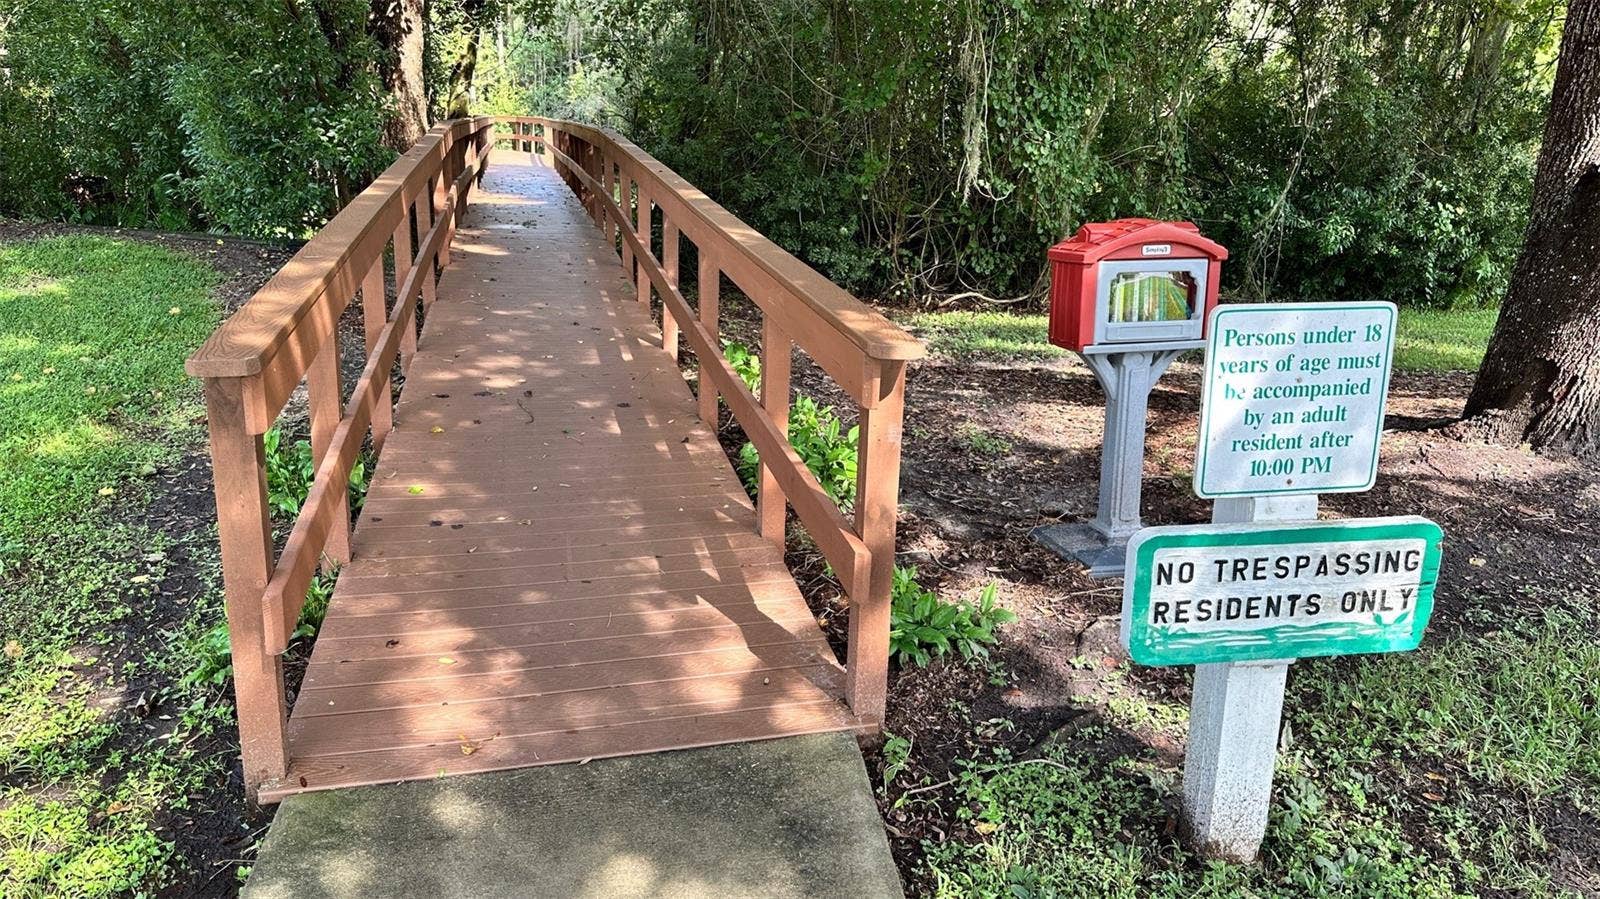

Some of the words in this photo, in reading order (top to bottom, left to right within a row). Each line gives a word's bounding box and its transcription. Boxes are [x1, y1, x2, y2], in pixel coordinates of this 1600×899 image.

[1224, 328, 1296, 347] Persons
[1303, 325, 1357, 344] under
[1364, 323, 1383, 342] 18
[1219, 359, 1269, 378] years
[1276, 354, 1295, 372] of
[1300, 357, 1331, 375] age
[1338, 352, 1382, 370] must
[1253, 377, 1371, 401] accompanied
[1243, 409, 1265, 430] by
[1271, 410, 1295, 425] an
[1301, 404, 1348, 423] adult
[1231, 433, 1303, 452] resident
[1309, 430, 1354, 448] after
[1249, 458, 1295, 477] 10:00
[1301, 455, 1333, 474] PM
[1156, 561, 1195, 586] NO
[1214, 549, 1421, 583] TRESPASSING
[1153, 593, 1321, 624] RESIDENTS
[1341, 587, 1415, 614] ONLY
